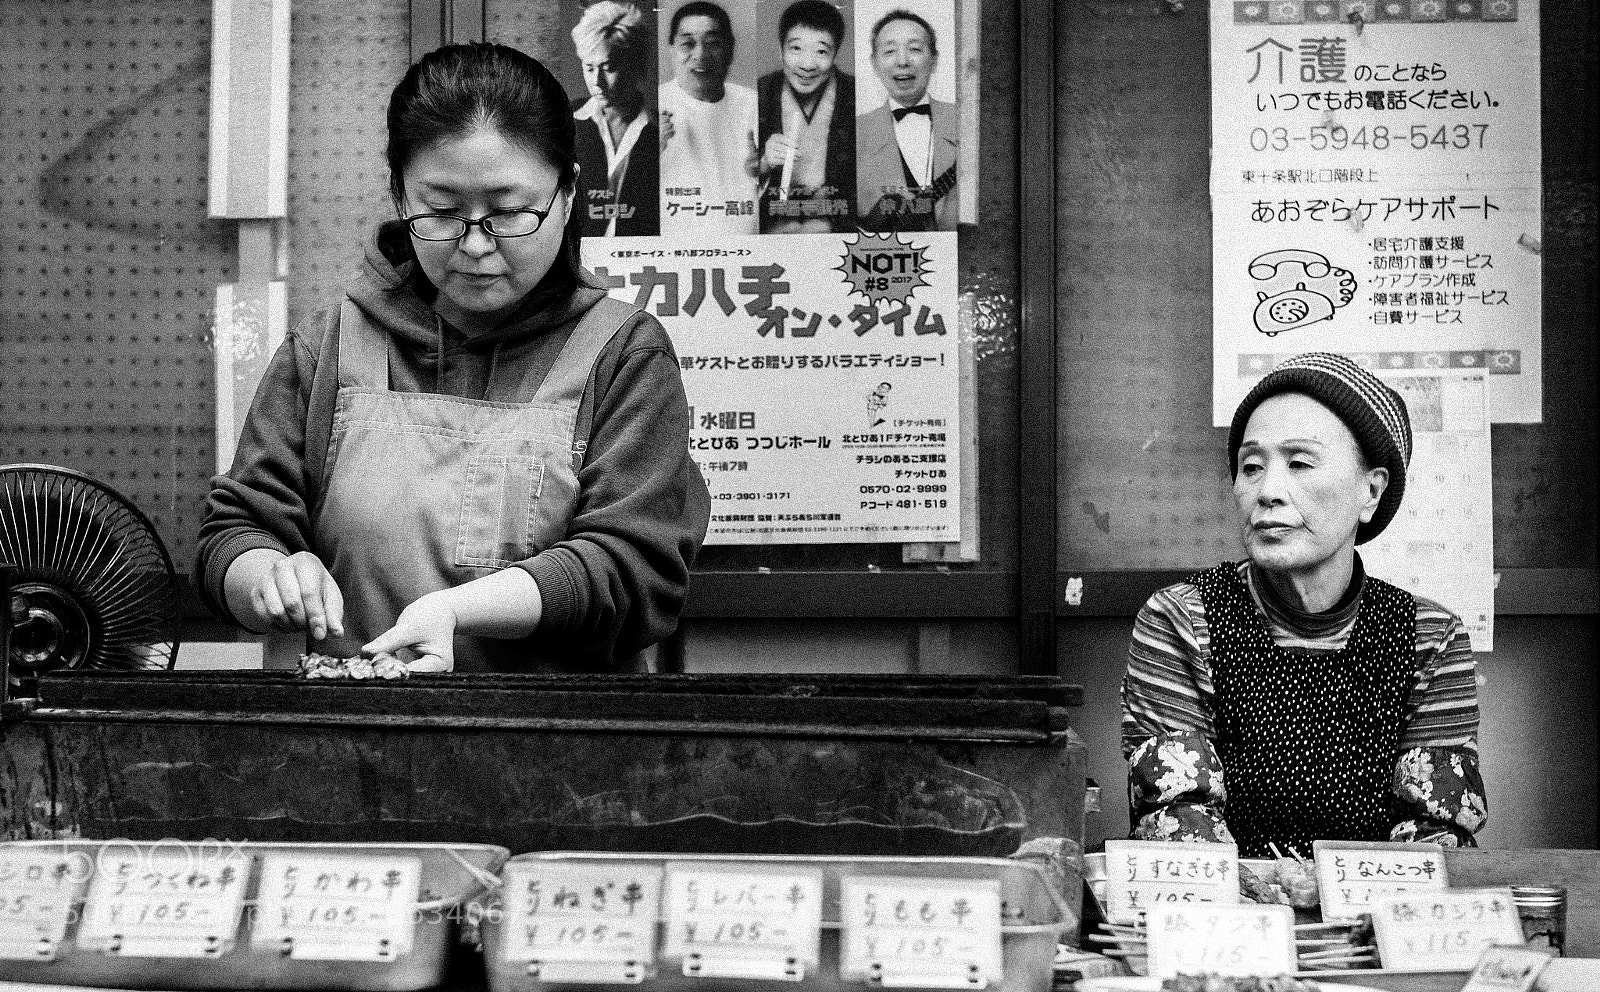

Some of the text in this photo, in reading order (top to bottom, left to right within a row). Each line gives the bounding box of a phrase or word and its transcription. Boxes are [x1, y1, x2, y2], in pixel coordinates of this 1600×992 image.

[1256, 89, 1500, 112] いつでもお電話ください。
[1250, 124, 1490, 151] 03-5948-5437
[1242, 168, 1379, 184] 東十条駅北口階段上
[588, 203, 636, 220] ヒロシ
[666, 200, 755, 217] ケーシー高峰
[1251, 195, 1499, 223] あおぞらケアサポート
[852, 252, 920, 274] NOT!
[891, 276, 913, 284] 2017
[700, 411, 756, 431] 水曜日
[746, 435, 832, 450] つつじホール
[1358, 859, 1436, 880] なんこつ串
